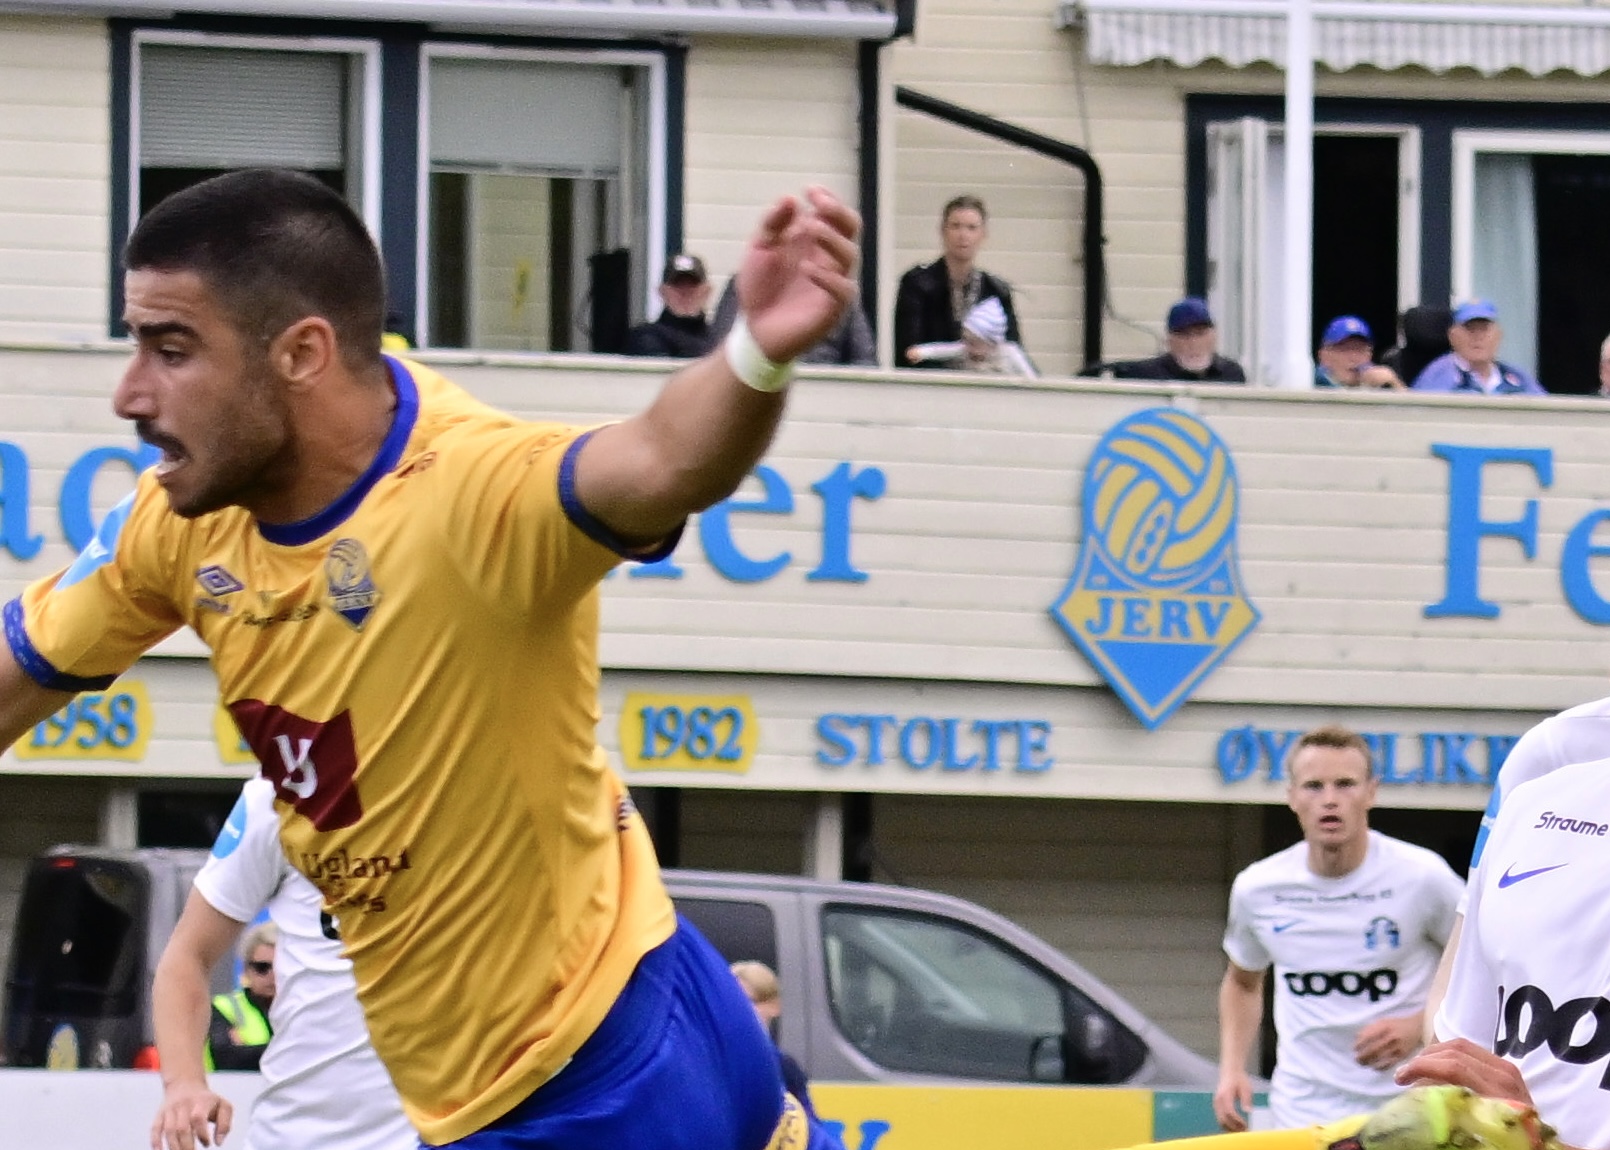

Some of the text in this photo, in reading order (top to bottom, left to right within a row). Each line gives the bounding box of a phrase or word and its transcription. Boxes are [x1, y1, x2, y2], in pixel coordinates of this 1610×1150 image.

[1085, 597, 1233, 639] JERV
[639, 705, 743, 760] 1982
[816, 713, 1053, 774] STOLTE
[1534, 811, 1609, 837] Straume
[1283, 968, 1398, 1003] coop
